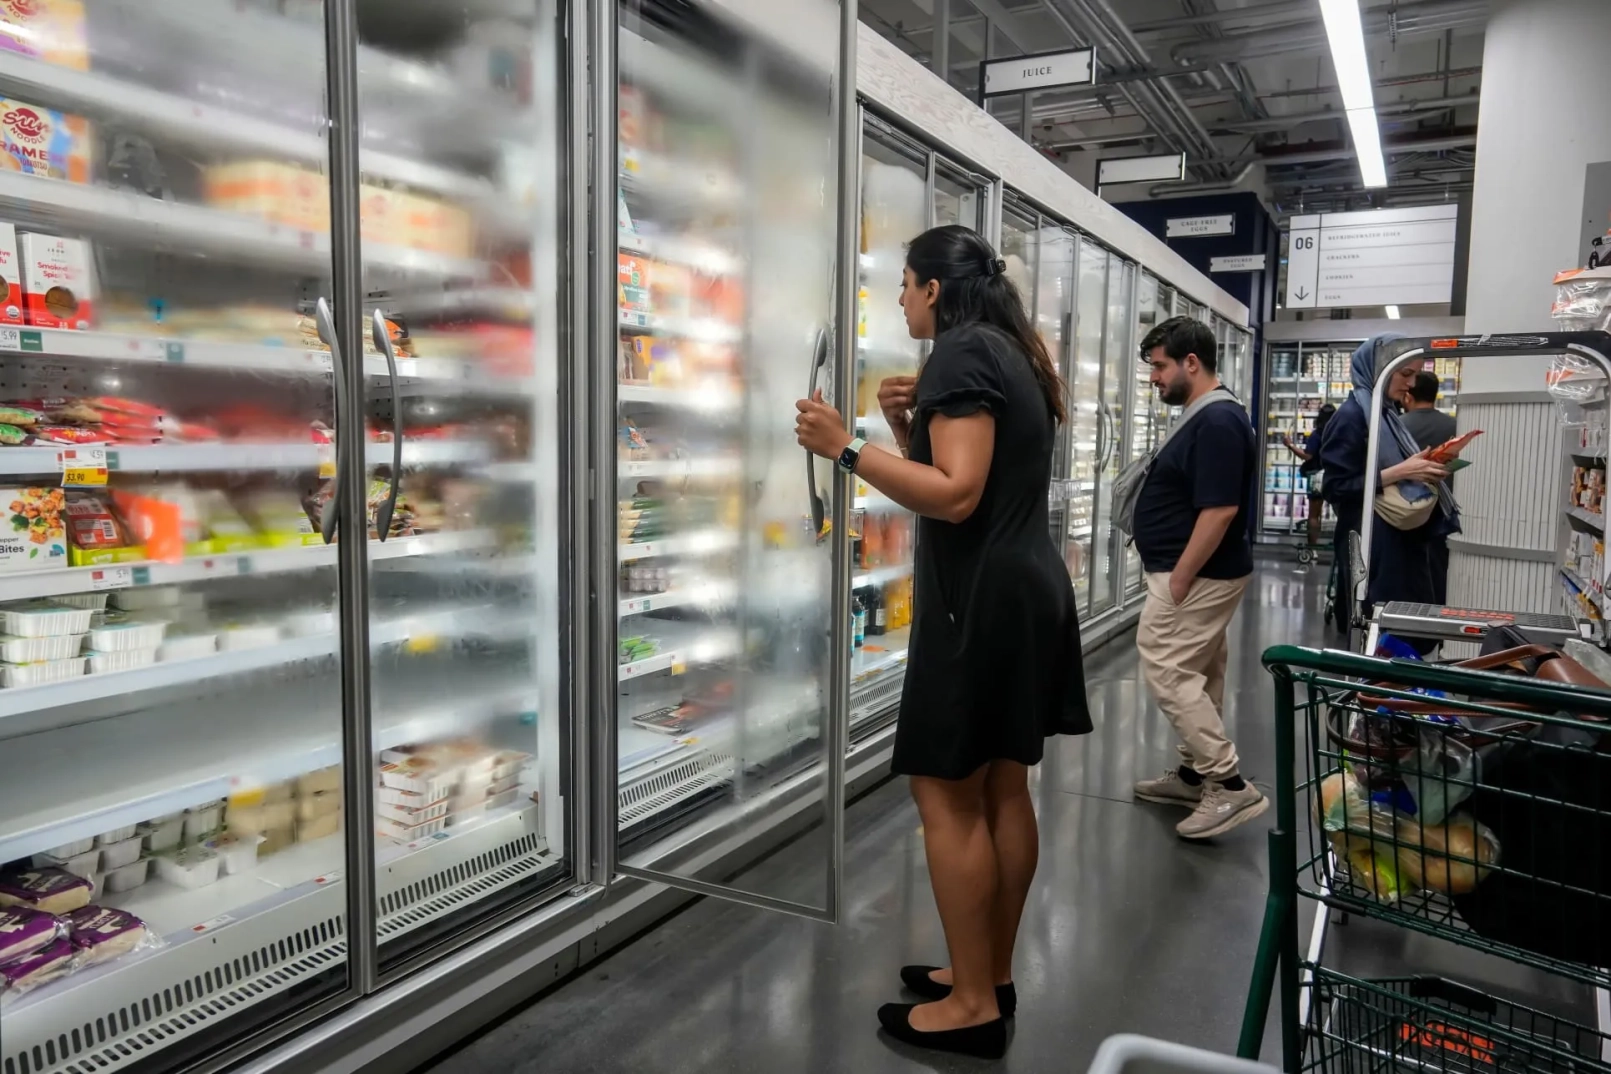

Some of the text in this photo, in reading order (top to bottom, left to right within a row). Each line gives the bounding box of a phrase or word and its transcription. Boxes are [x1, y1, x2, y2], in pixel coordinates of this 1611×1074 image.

[1022, 66, 1052, 78] JUICE
[0, 140, 48, 160] RAME
[1295, 236, 1314, 250] 06
[66, 473, 85, 482] $3.90
